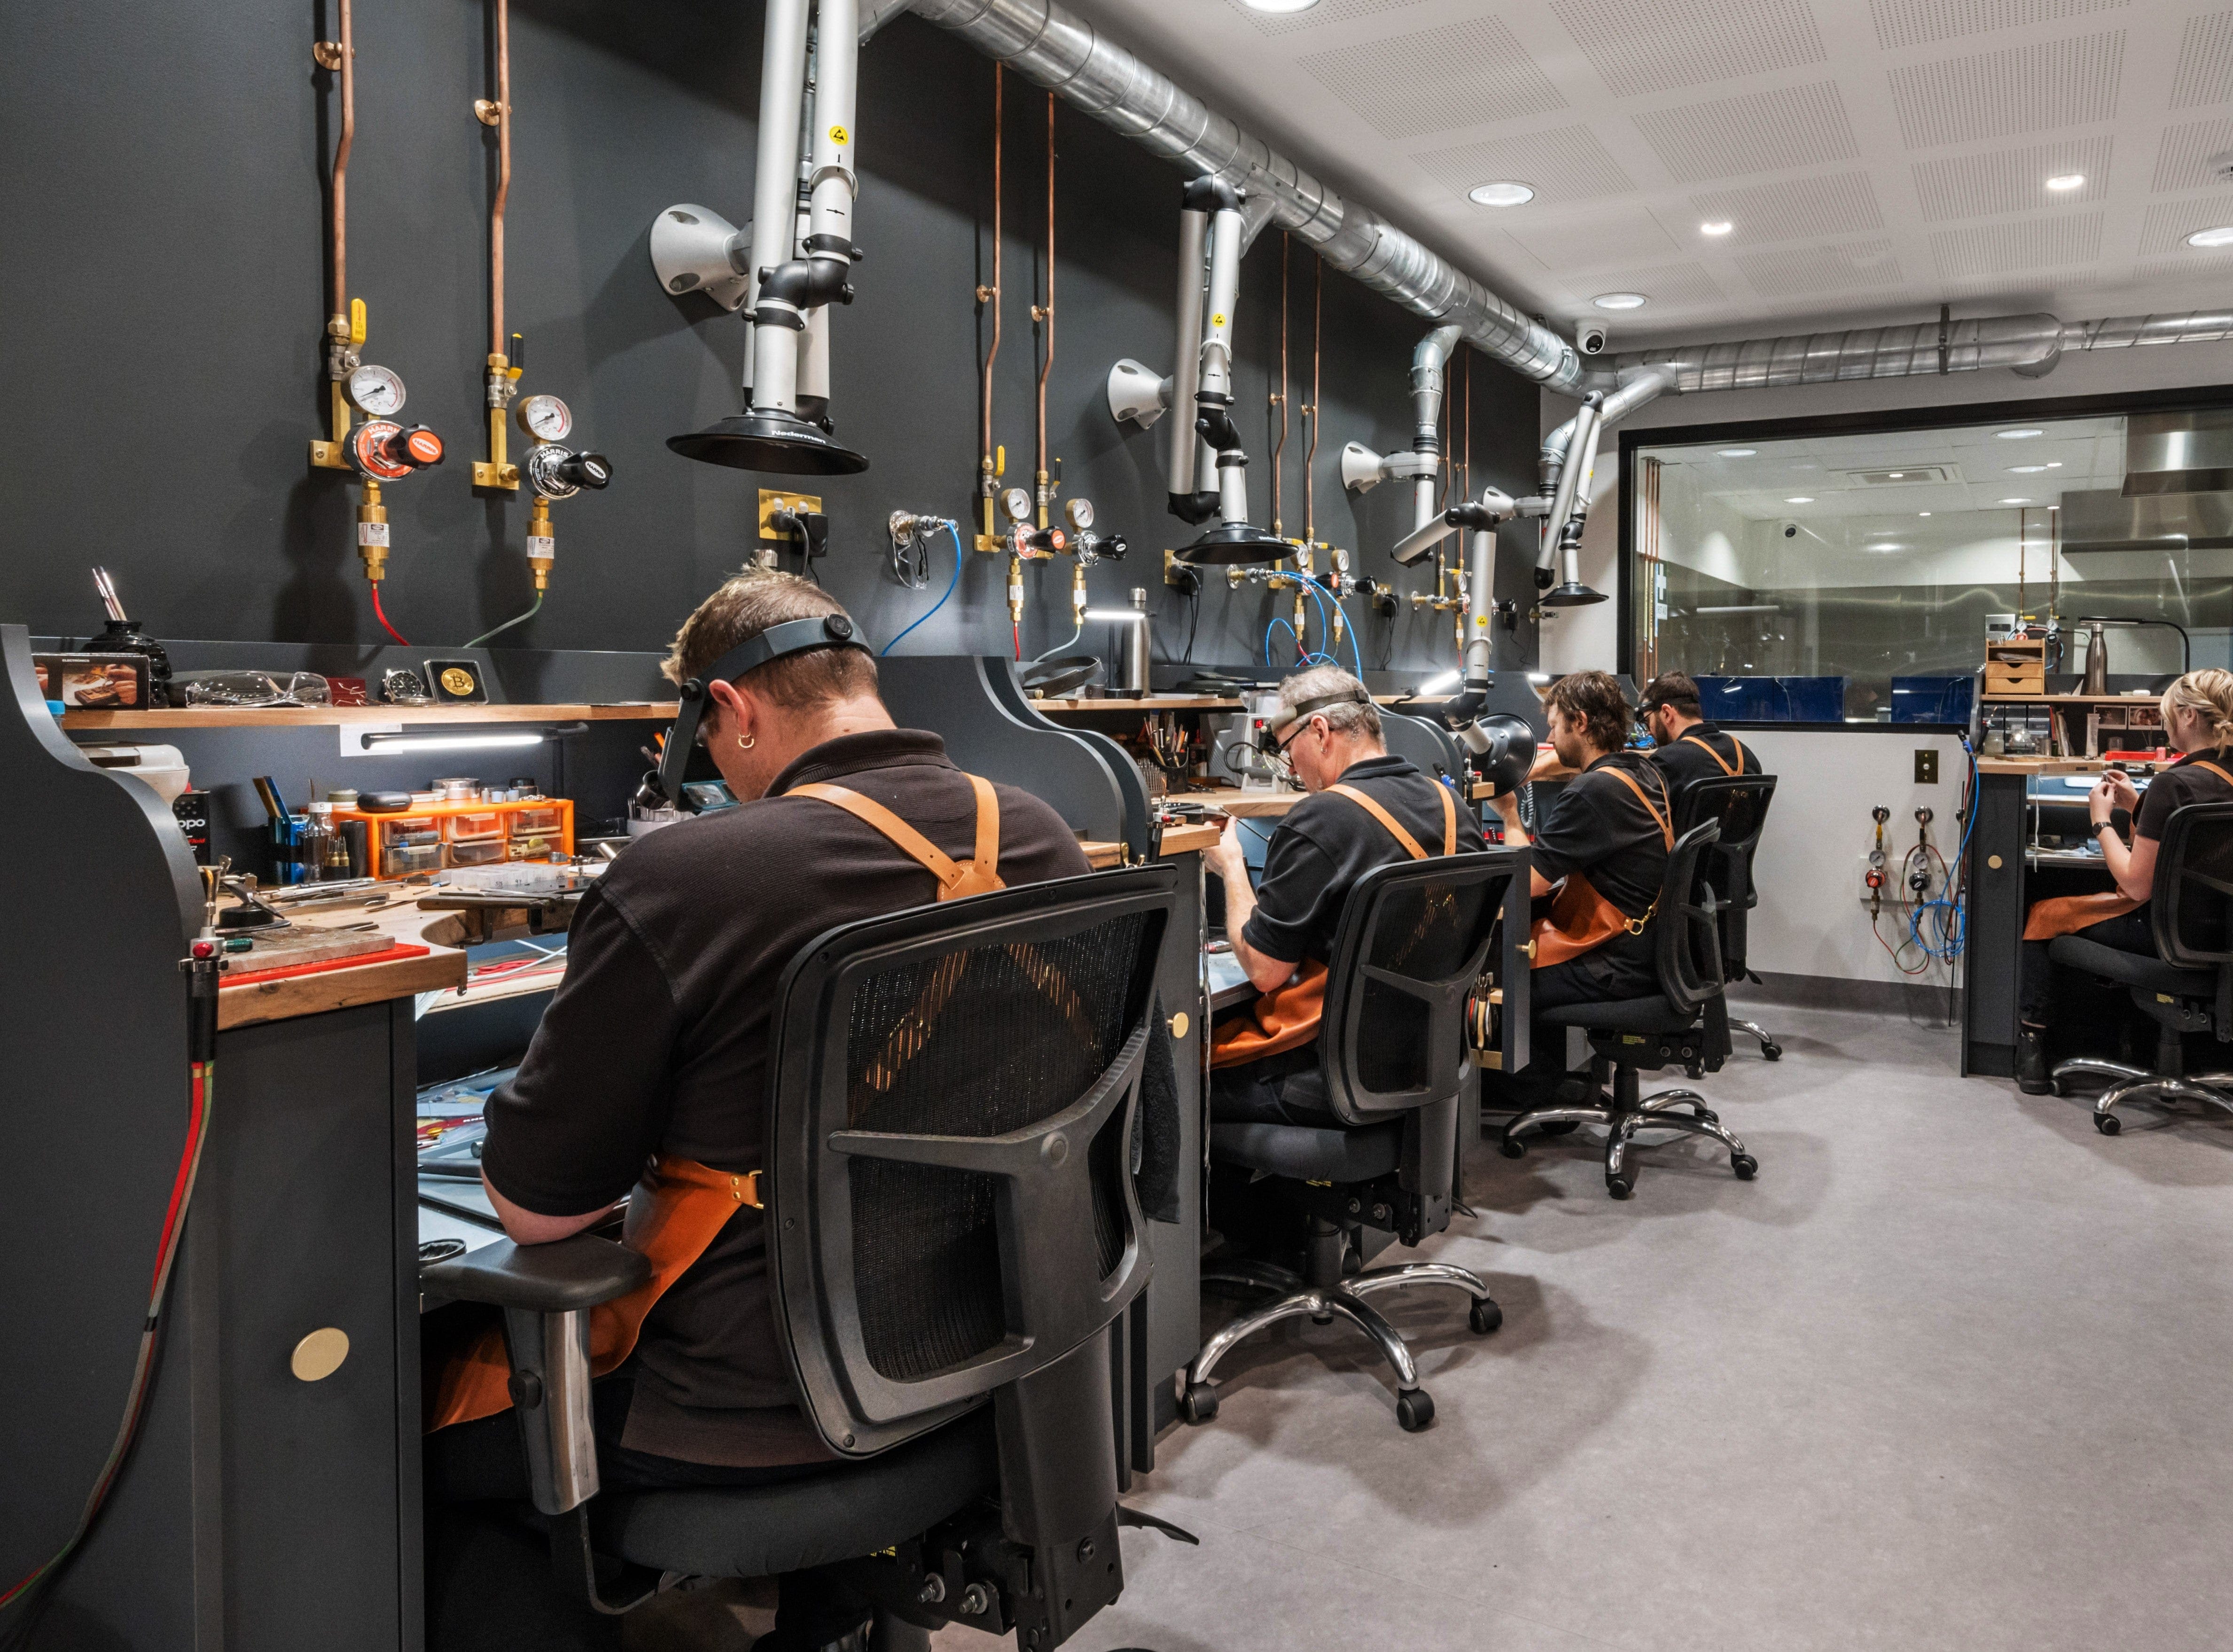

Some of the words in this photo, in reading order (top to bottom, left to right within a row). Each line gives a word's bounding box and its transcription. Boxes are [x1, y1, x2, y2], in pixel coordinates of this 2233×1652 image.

[367, 425, 399, 434] HARRI
[771, 430, 826, 444] Nederman
[414, 439, 437, 453] HARRIS
[539, 449, 569, 459] HARRIS
[586, 462, 605, 477] HARRIS
[179, 818, 205, 830] ppo
